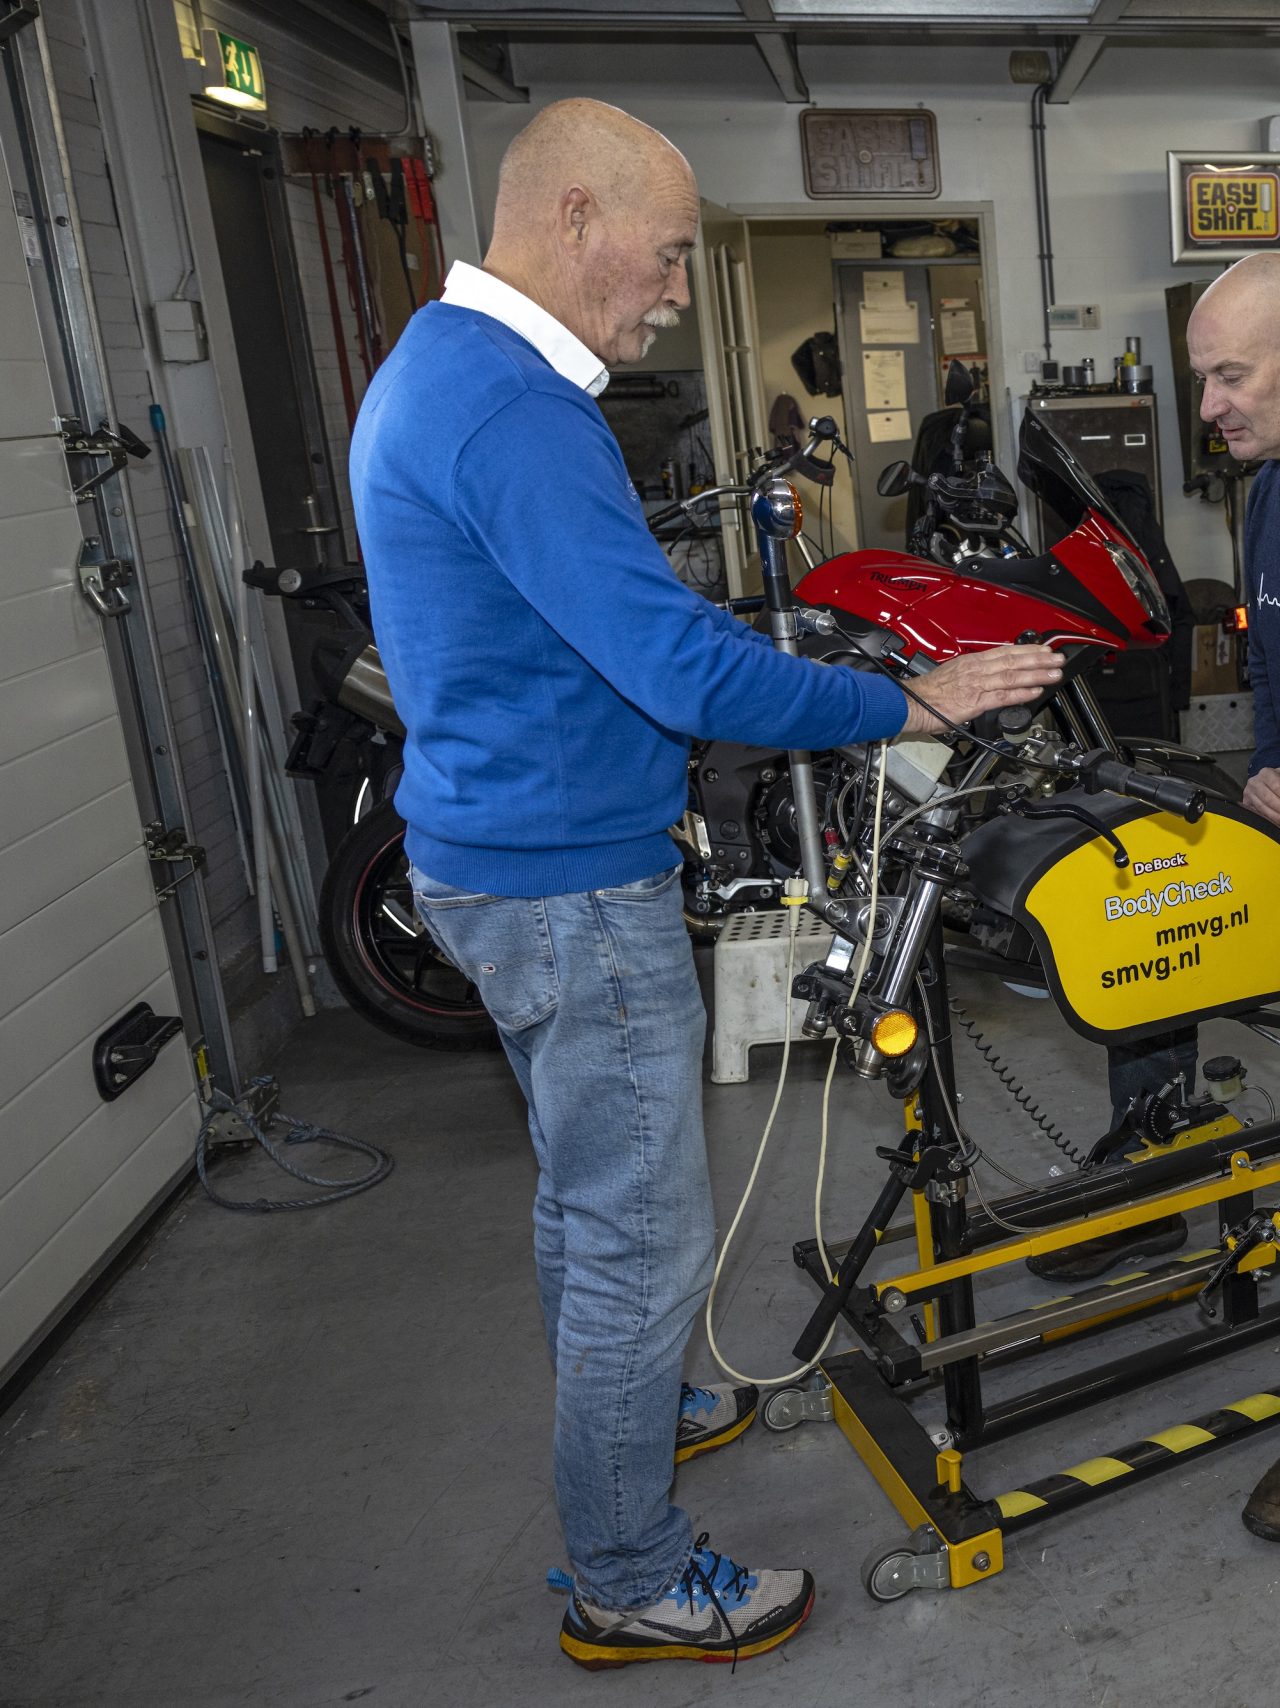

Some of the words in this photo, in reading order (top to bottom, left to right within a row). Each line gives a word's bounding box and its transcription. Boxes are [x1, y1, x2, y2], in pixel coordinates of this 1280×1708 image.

[1196, 182, 1257, 206] EASY
[869, 571, 928, 592] TRIUMPH
[1104, 871, 1233, 921] BodyCheck
[1156, 903, 1249, 947] mmvg.nl
[1101, 942, 1201, 989] smvg.nl
